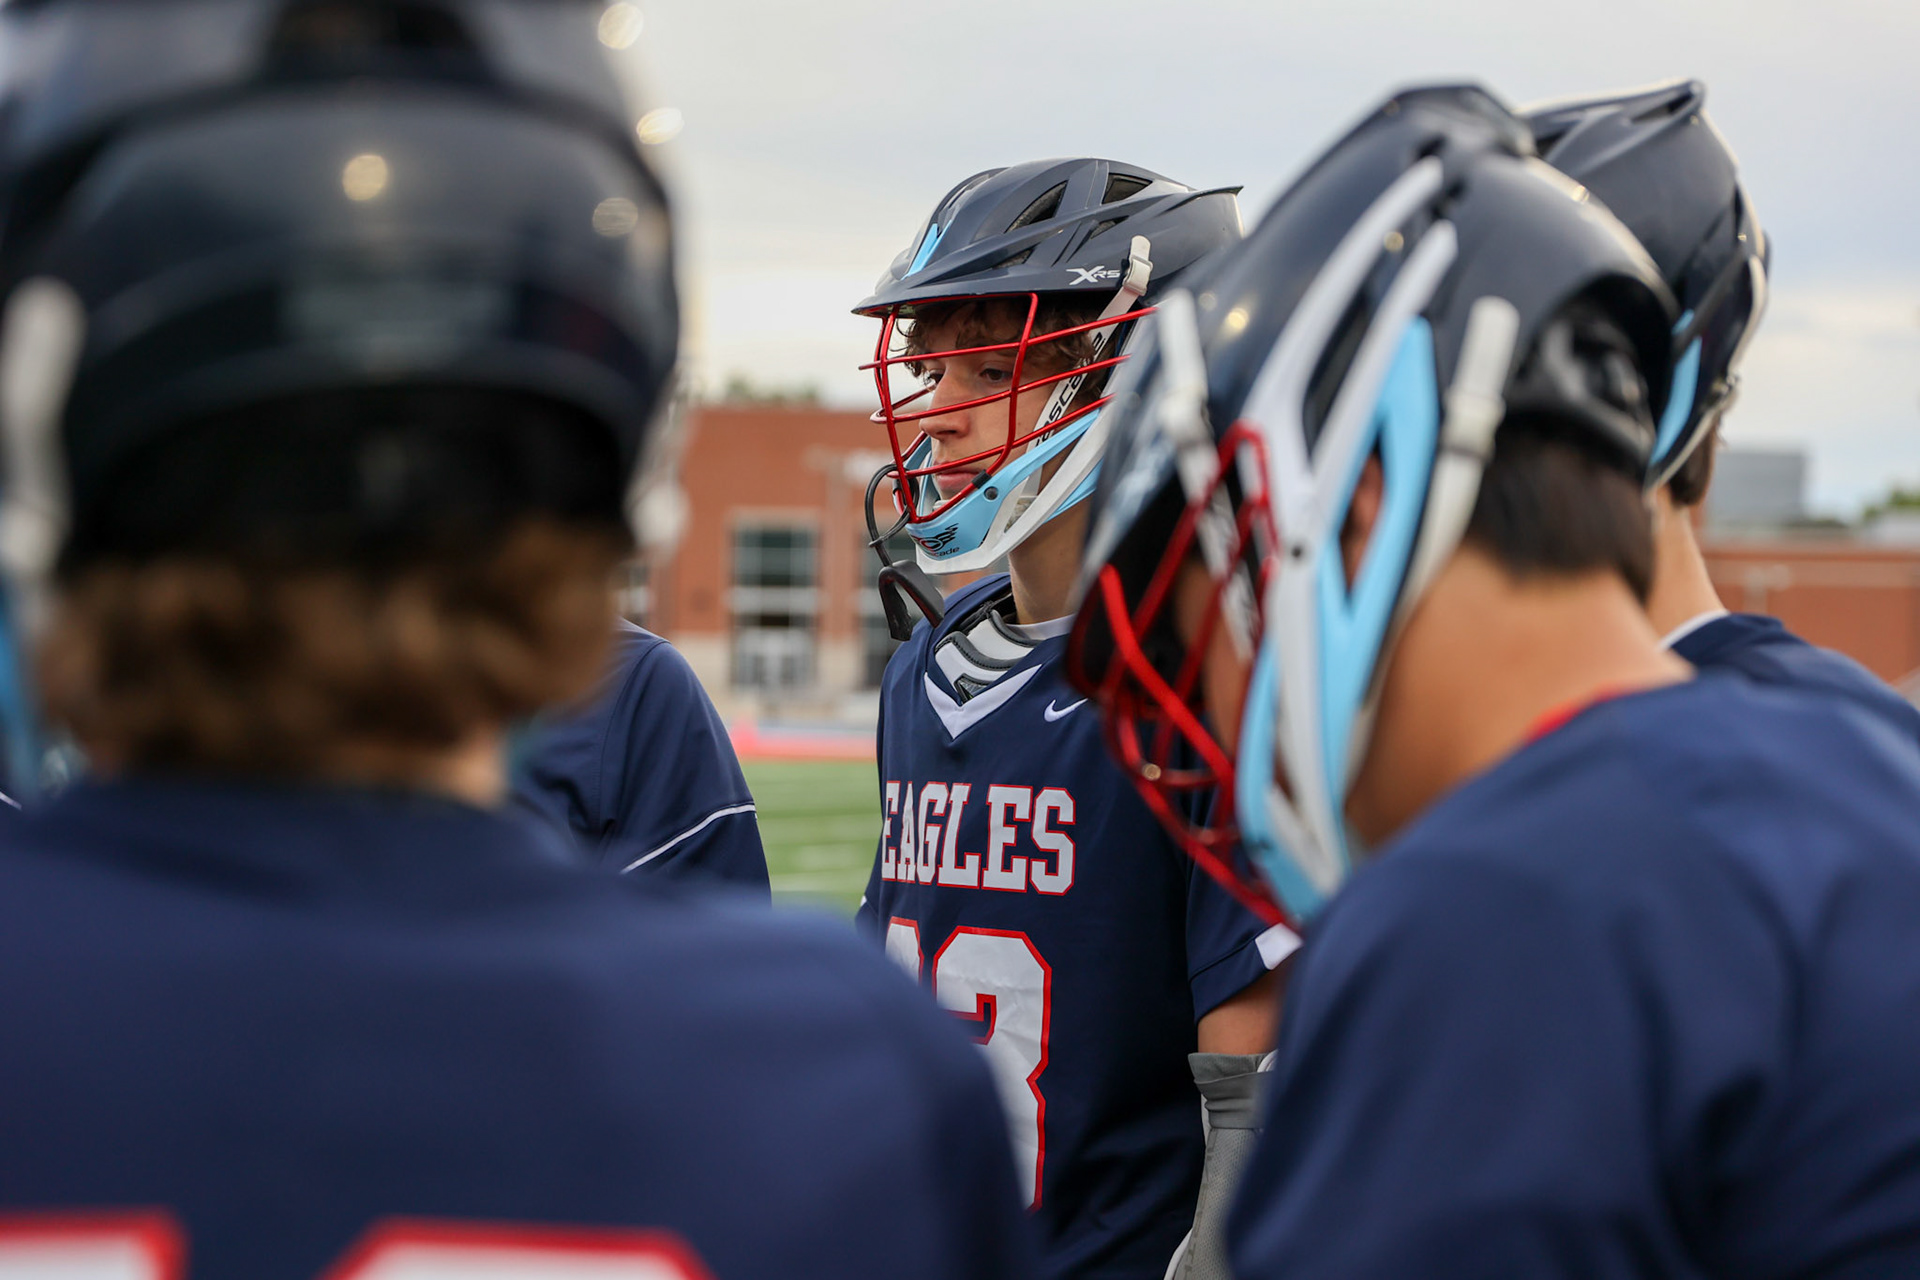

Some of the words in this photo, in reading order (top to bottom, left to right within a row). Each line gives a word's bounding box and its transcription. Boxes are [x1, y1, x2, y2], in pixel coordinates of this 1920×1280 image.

[1066, 265, 1121, 286] XRS
[881, 780, 1076, 896] EAGLES
[885, 916, 1052, 1214] 3
